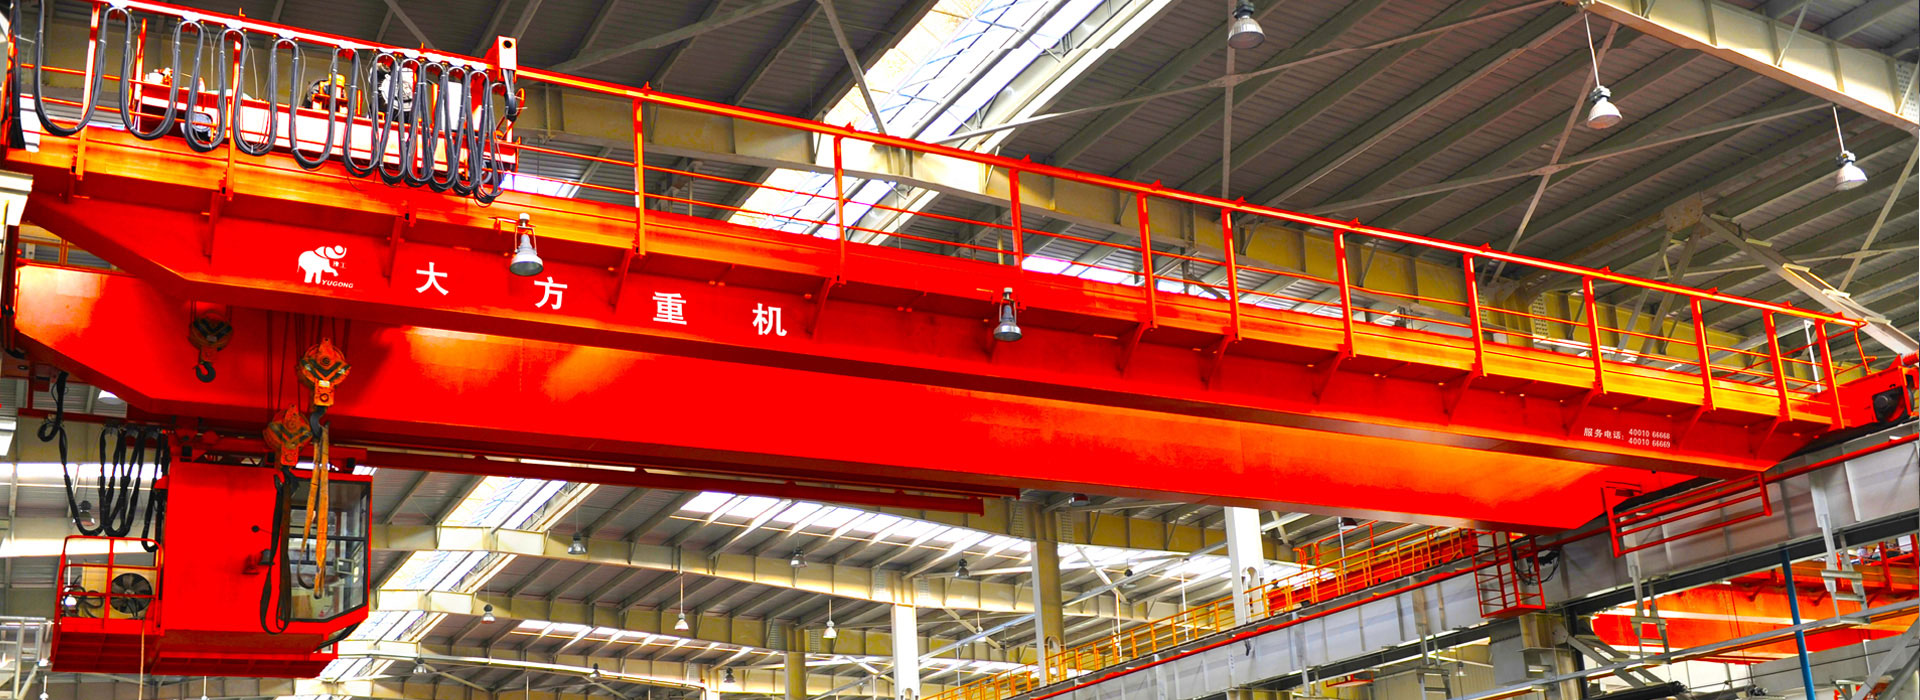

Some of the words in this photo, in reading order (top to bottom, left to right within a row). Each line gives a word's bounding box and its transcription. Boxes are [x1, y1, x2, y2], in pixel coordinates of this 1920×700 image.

[322, 279, 354, 289] YUGONG
[415, 261, 788, 337] 大方重机
[1628, 428, 1650, 438] 40010
[1628, 437, 1650, 446] 40010
